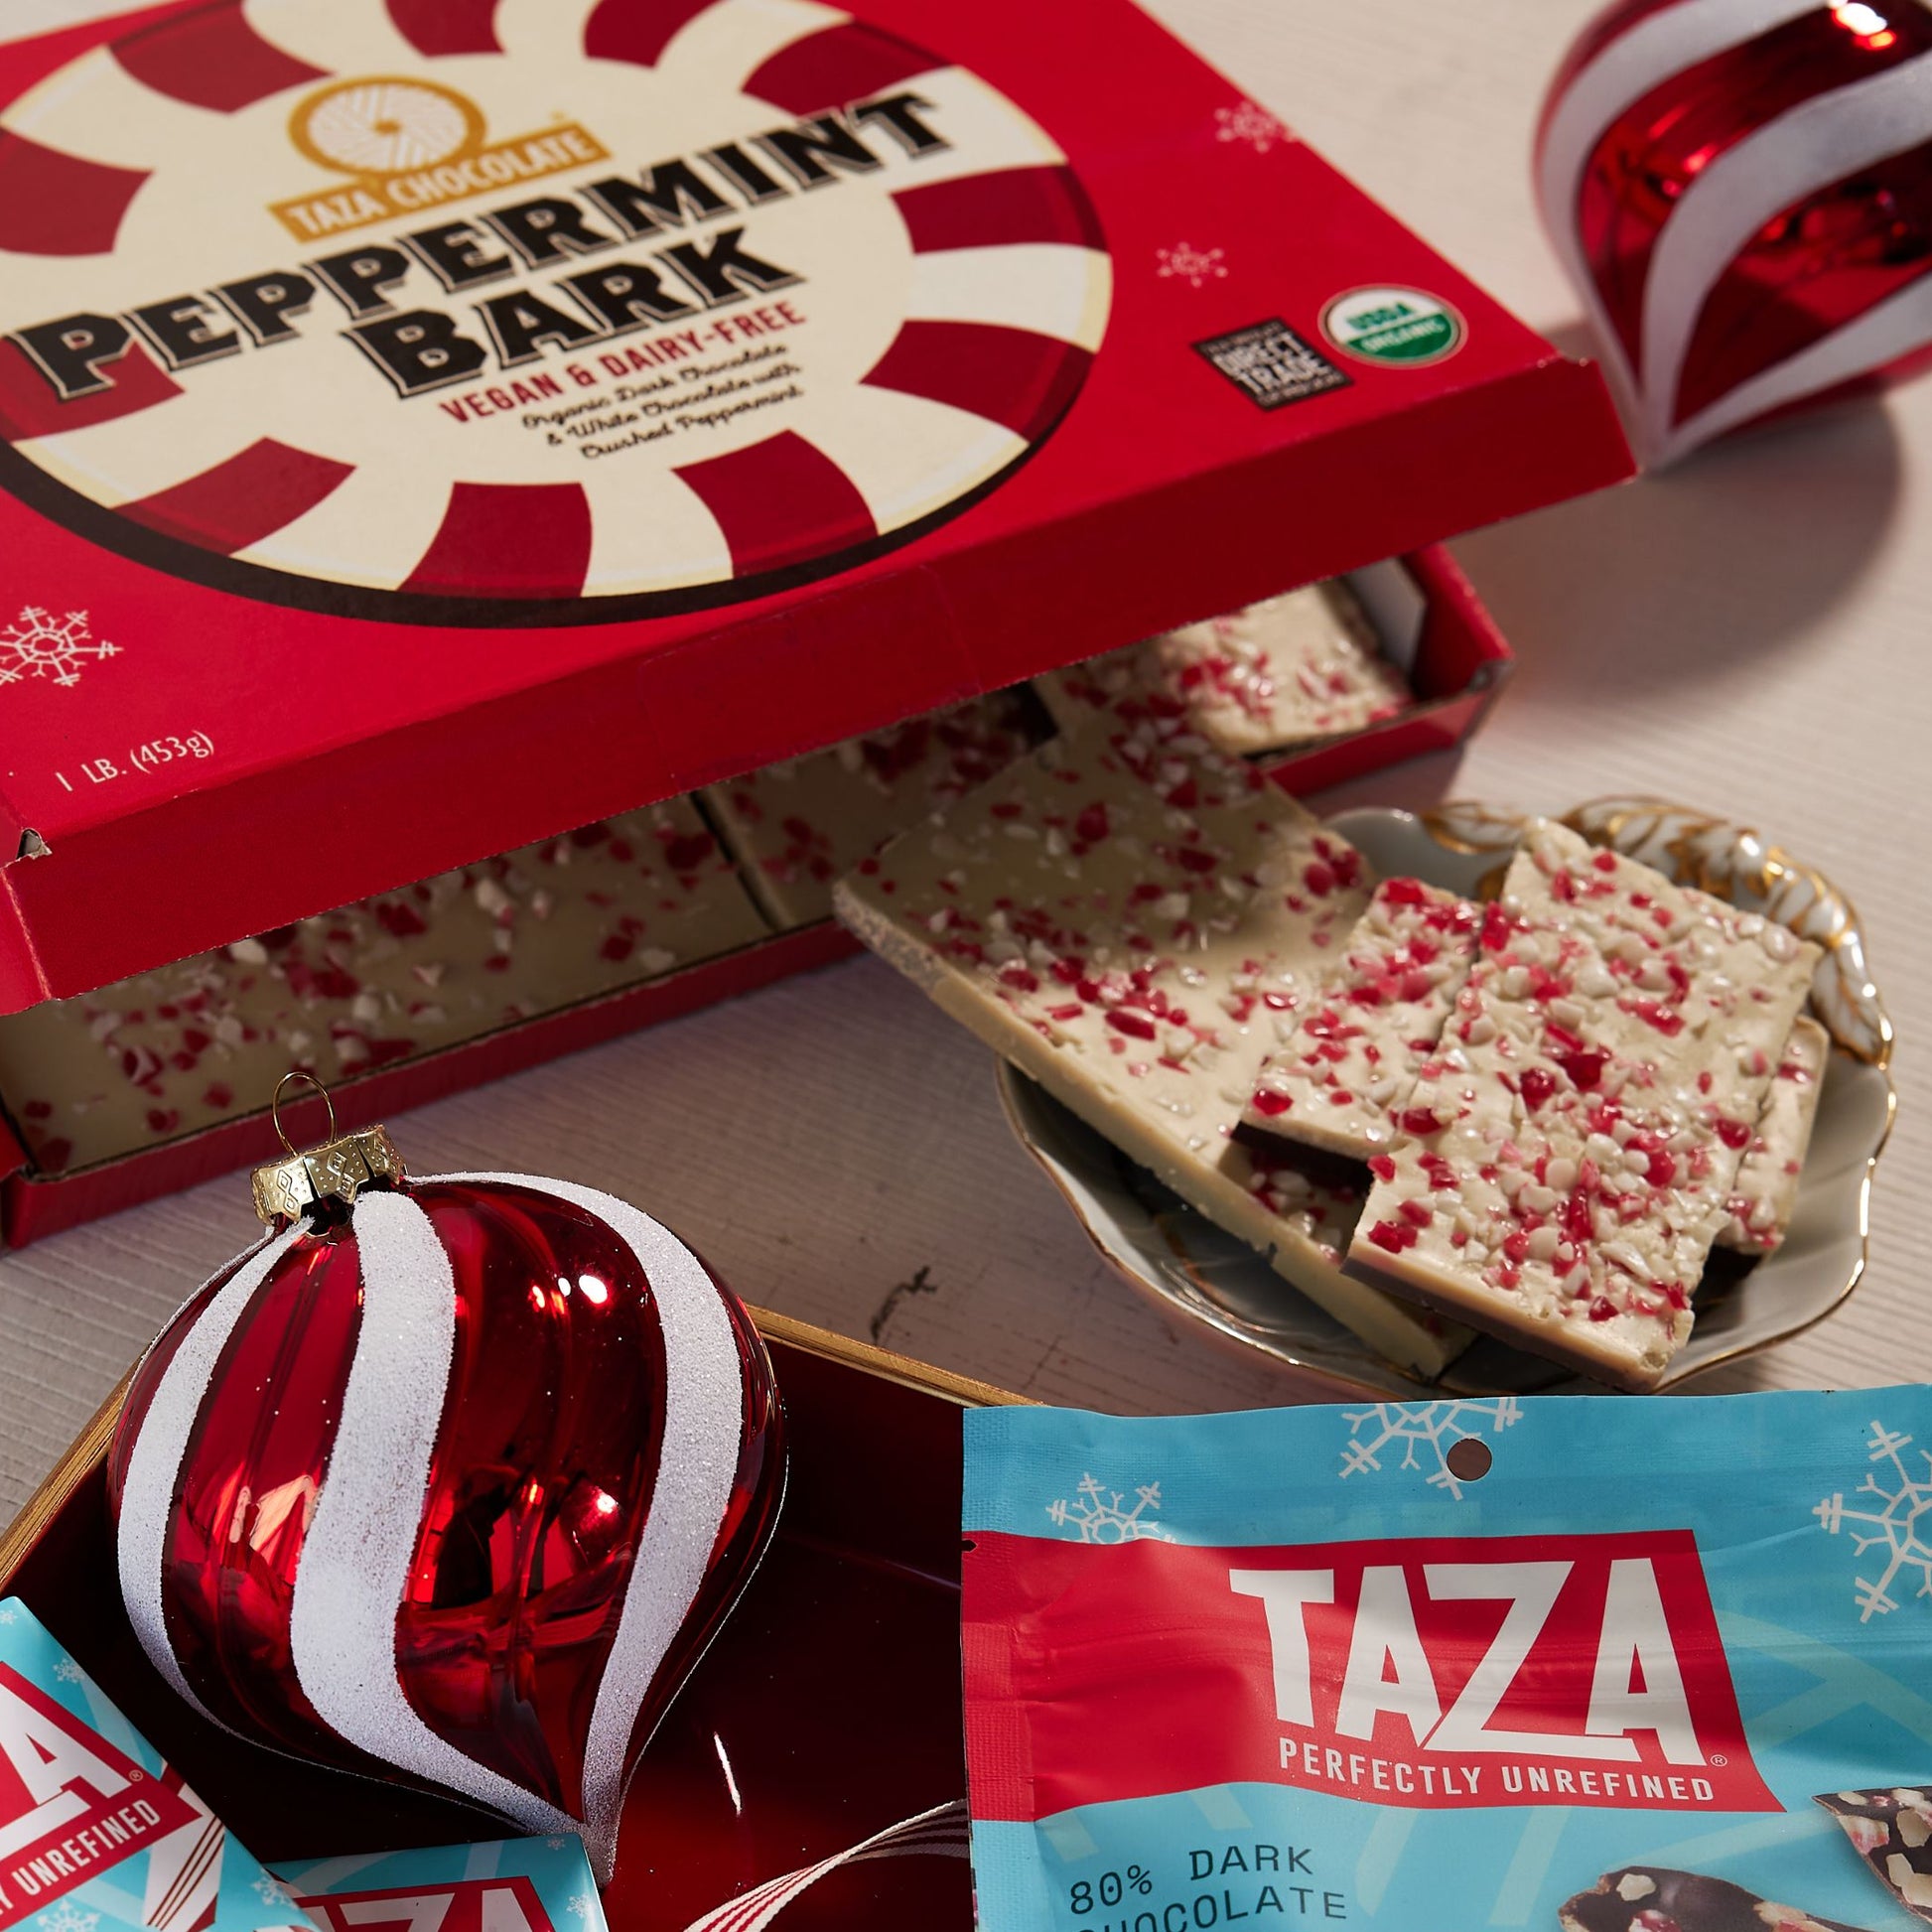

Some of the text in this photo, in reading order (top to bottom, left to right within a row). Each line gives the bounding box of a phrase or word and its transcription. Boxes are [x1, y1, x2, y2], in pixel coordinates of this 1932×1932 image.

[286, 128, 596, 234] TAZA CHOCOLATE
[2, 91, 953, 403] PEPPERMINT
[339, 225, 807, 399] BARK
[439, 300, 807, 424] VEGAN & DAIRY-FREE
[521, 345, 787, 429] Organic Dark Chocolate
[567, 411, 639, 439] White
[641, 379, 752, 417] Chocolate
[581, 384, 805, 459] Crushed Peppermint
[80, 759, 128, 783] LB.
[130, 730, 215, 774] (453g)
[1229, 1558, 1708, 1766] TAZA
[1279, 1736, 1715, 1801] PERFECTLY UNREFINED
[11, 1799, 161, 1896] UNREFINED
[1070, 1845, 1313, 1915] 80% DARK
[1077, 1885, 1347, 1932] OCOLATE
